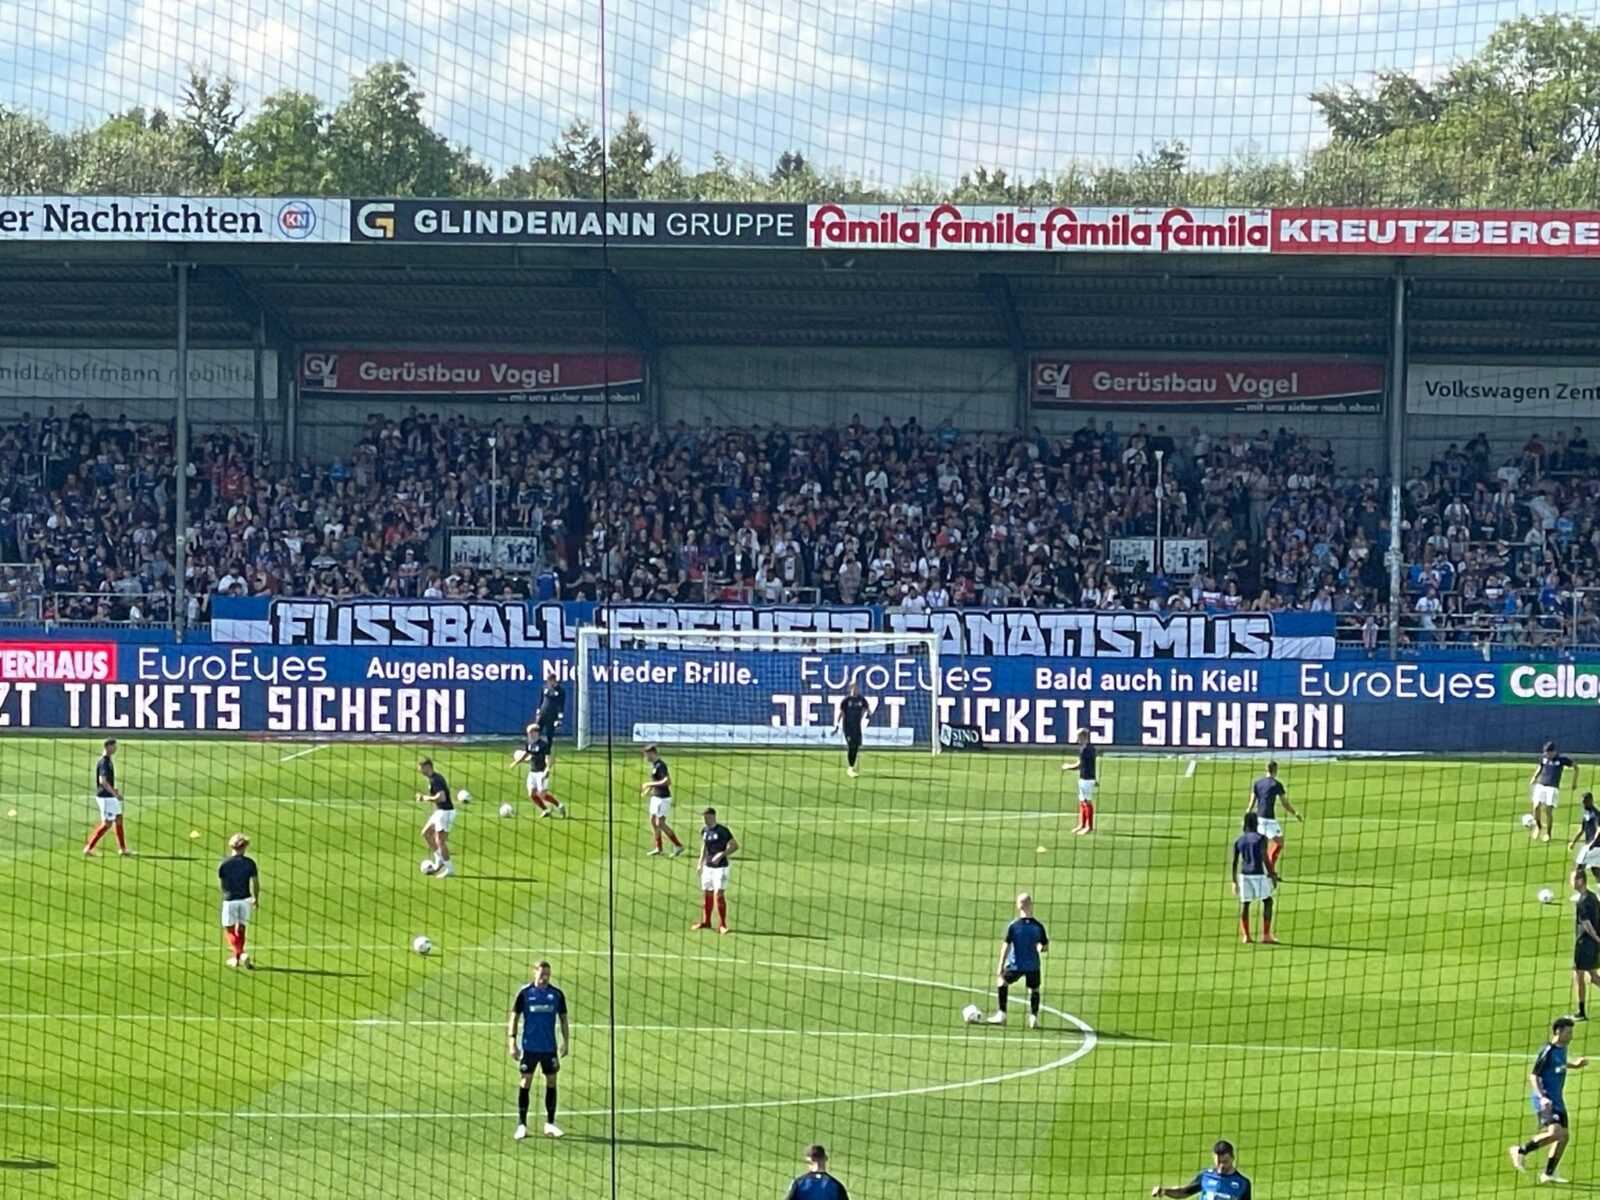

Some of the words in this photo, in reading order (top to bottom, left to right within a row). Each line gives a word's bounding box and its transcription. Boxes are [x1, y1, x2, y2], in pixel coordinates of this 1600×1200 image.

[0, 210, 34, 232] er
[43, 203, 263, 233] Nachrichten
[414, 209, 656, 236] GLINDEMANN
[666, 212, 794, 237] GRUPPE
[809, 203, 920, 248] famila
[925, 204, 1036, 249] famila
[1040, 206, 1151, 250] famila
[1157, 208, 1269, 251] famila
[1279, 218, 1600, 245] KREUTZBERGE
[359, 361, 481, 383] Gerüstbau
[489, 363, 561, 388] Vogel
[1092, 371, 1217, 393] Gerüstbau
[1226, 373, 1299, 398] Vogel
[1425, 380, 1550, 403] Volkswagen
[275, 602, 598, 649] FUSSBALL
[889, 610, 1272, 659] FANATISMUS
[0, 650, 109, 680] ERHAUS
[138, 647, 327, 686] EuroEyes
[367, 656, 533, 684] Augenlasern.
[592, 659, 678, 684] wieder
[684, 661, 759, 685] Brille.
[801, 657, 993, 696] EuroEyes
[1035, 667, 1092, 689] Bald
[1100, 668, 1162, 691] auch
[1170, 668, 1194, 691] in
[1202, 669, 1259, 692] Kiel!
[1300, 663, 1496, 704] EuroEyes
[1510, 664, 1600, 703] Cella
[64, 682, 241, 730] TICKETS
[268, 686, 466, 733] SICHERN!
[937, 697, 1114, 745] TICKETS
[1142, 701, 1343, 749] SICHERN!
